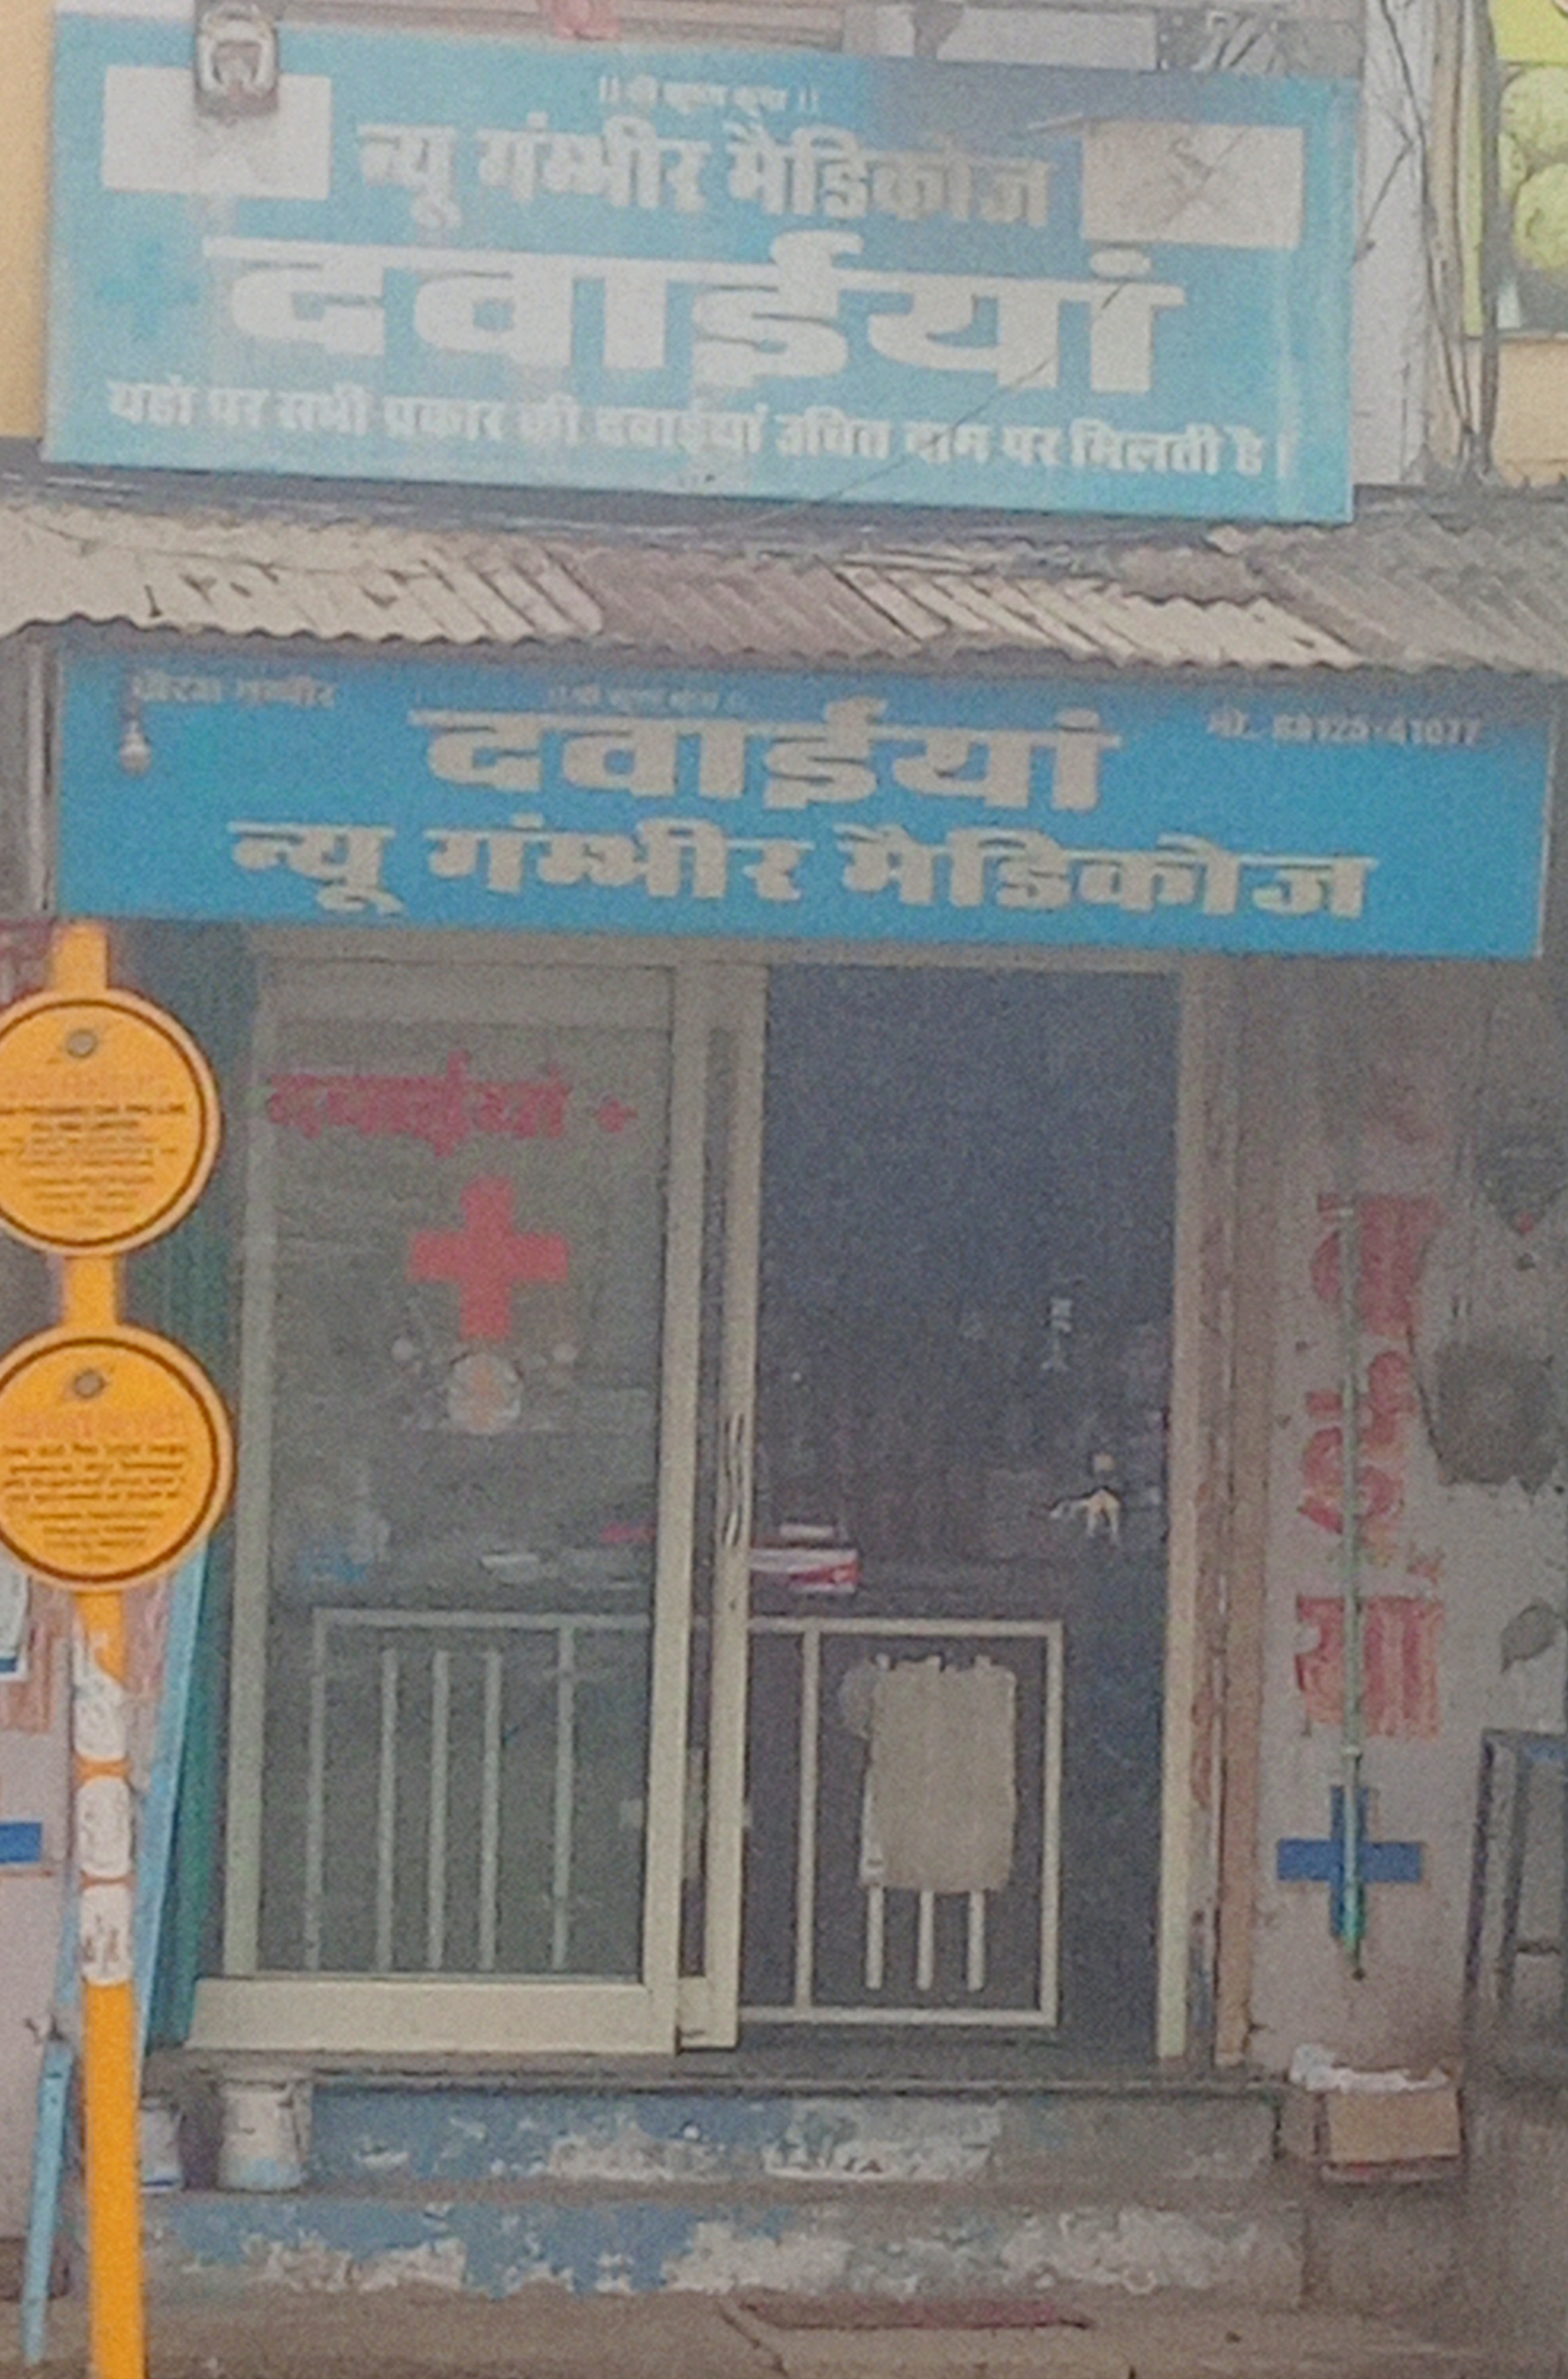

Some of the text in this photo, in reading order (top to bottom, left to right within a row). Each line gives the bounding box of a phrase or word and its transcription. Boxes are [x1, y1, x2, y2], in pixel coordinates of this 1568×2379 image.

[357, 123, 464, 228] न्यू
[203, 231, 1186, 395] दवाईयां
[1002, 423, 1061, 468] पर
[1070, 417, 1221, 476] मिलती
[408, 696, 1122, 811] दवाईयां
[227, 821, 405, 916] न्यू
[832, 823, 1379, 918] मैडिकोज
